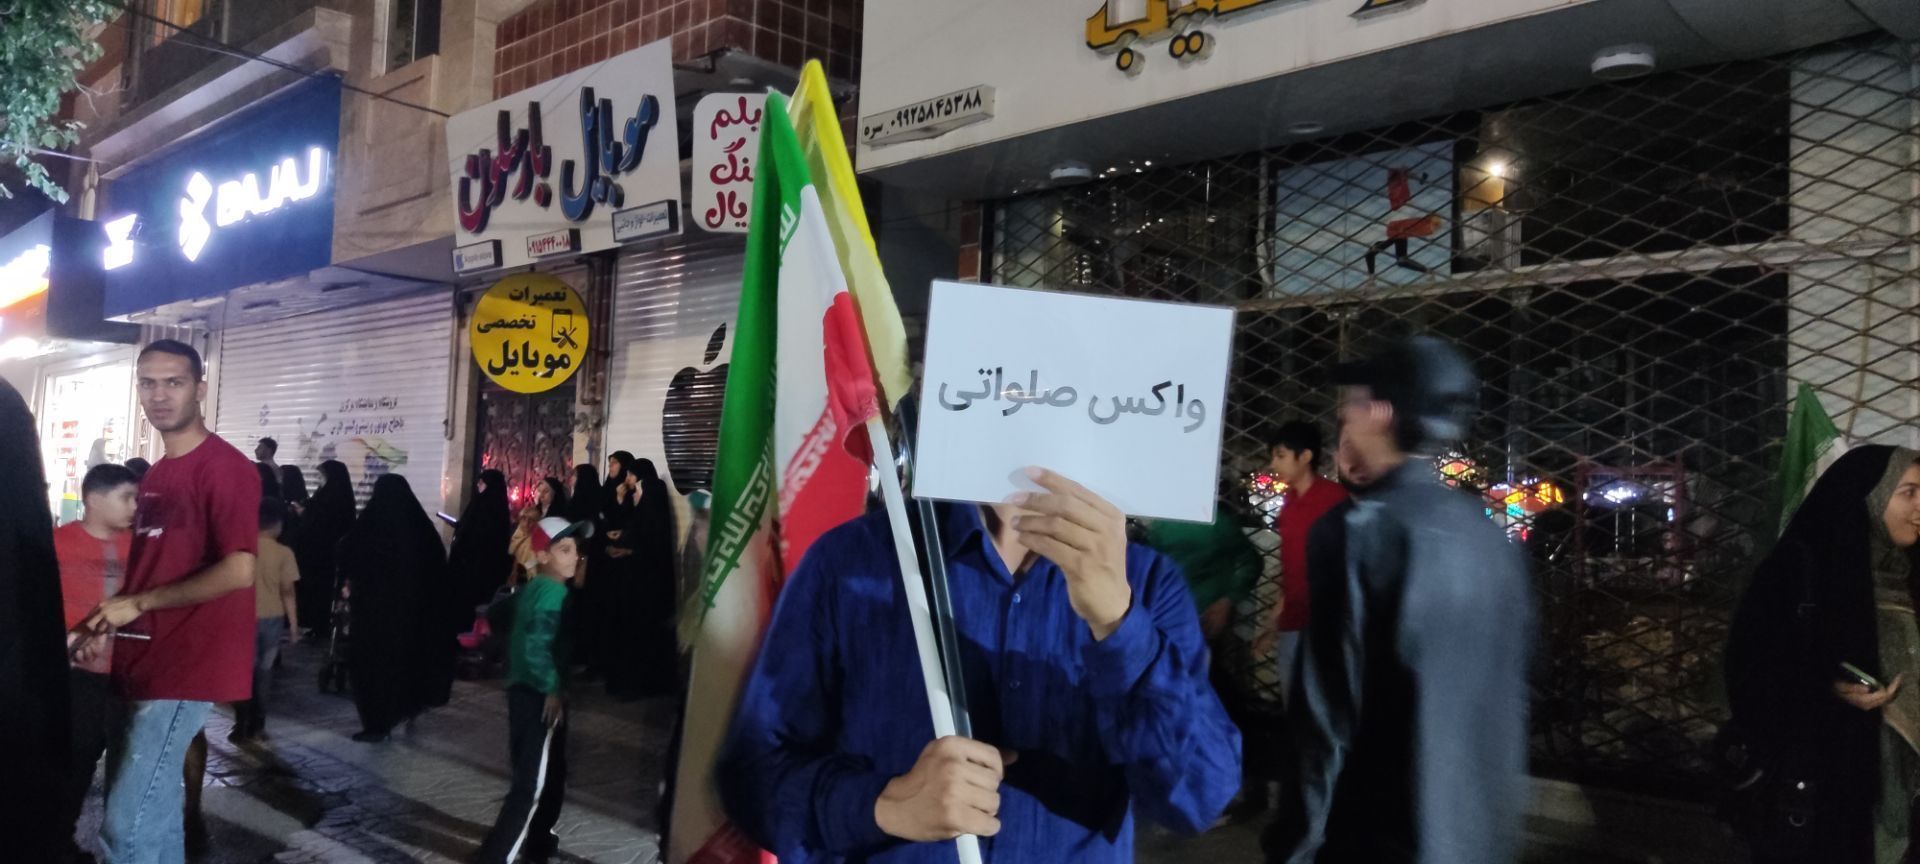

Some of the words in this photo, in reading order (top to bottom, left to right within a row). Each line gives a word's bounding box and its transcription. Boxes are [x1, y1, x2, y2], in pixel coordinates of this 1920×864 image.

[559, 86, 660, 221] موبایل
[216, 147, 321, 228] BAJAJ
[509, 286, 567, 306] تعمیرات
[477, 314, 536, 333] تخصصی
[488, 339, 571, 378] موبایل
[938, 366, 1077, 417] صلواتی
[1088, 380, 1206, 433] واکس
